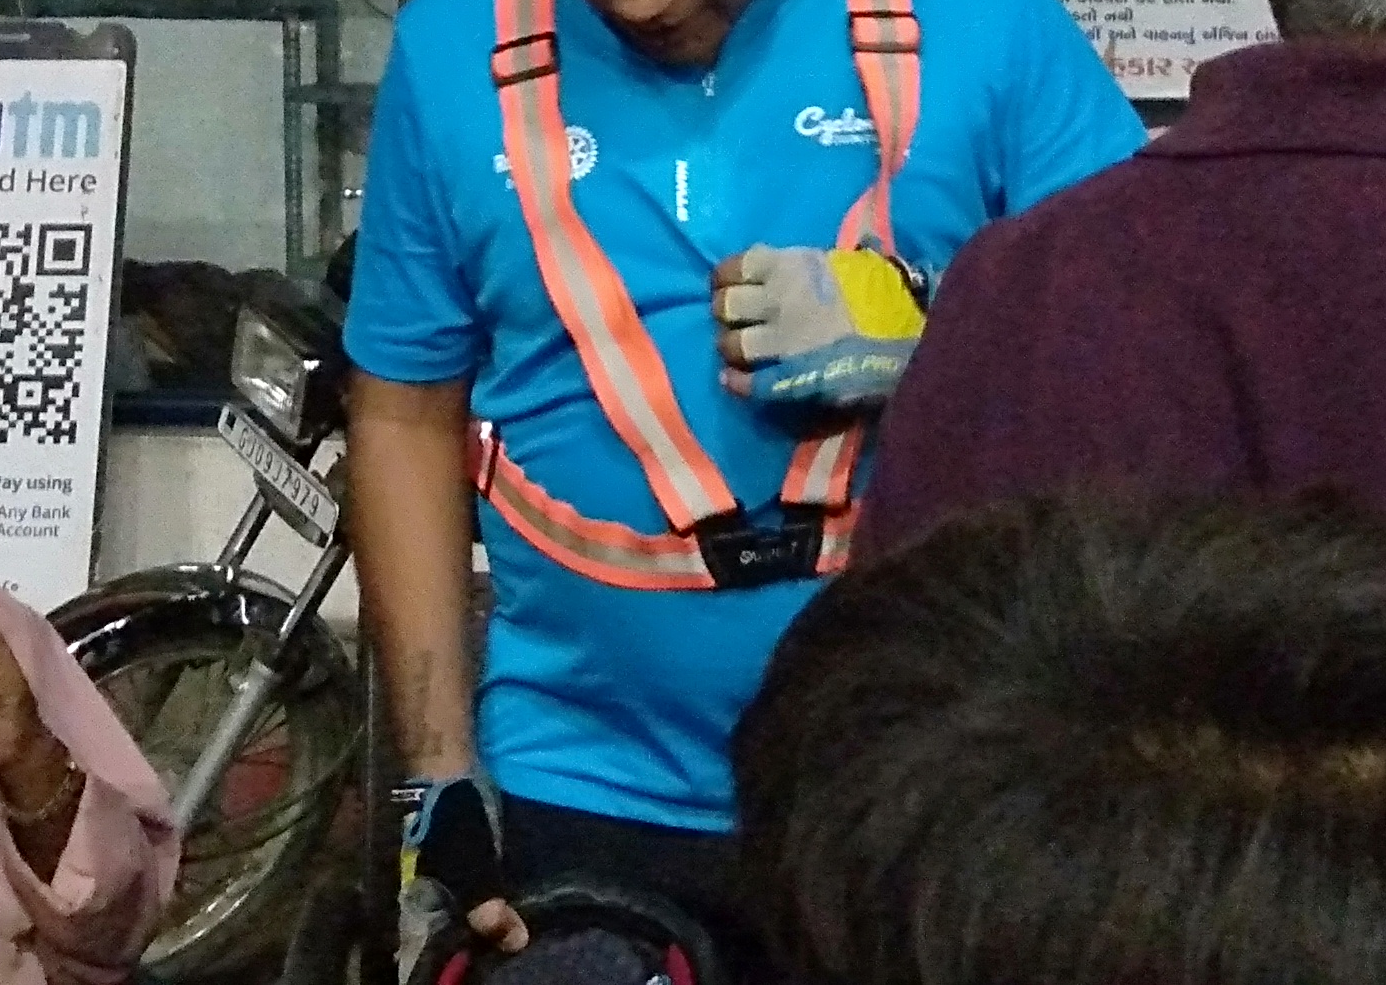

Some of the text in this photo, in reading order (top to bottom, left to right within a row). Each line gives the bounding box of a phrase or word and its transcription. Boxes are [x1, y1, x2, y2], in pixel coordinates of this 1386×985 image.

[26, 169, 98, 194] Here
[26, 474, 74, 494] using
[31, 504, 71, 520] Bank
